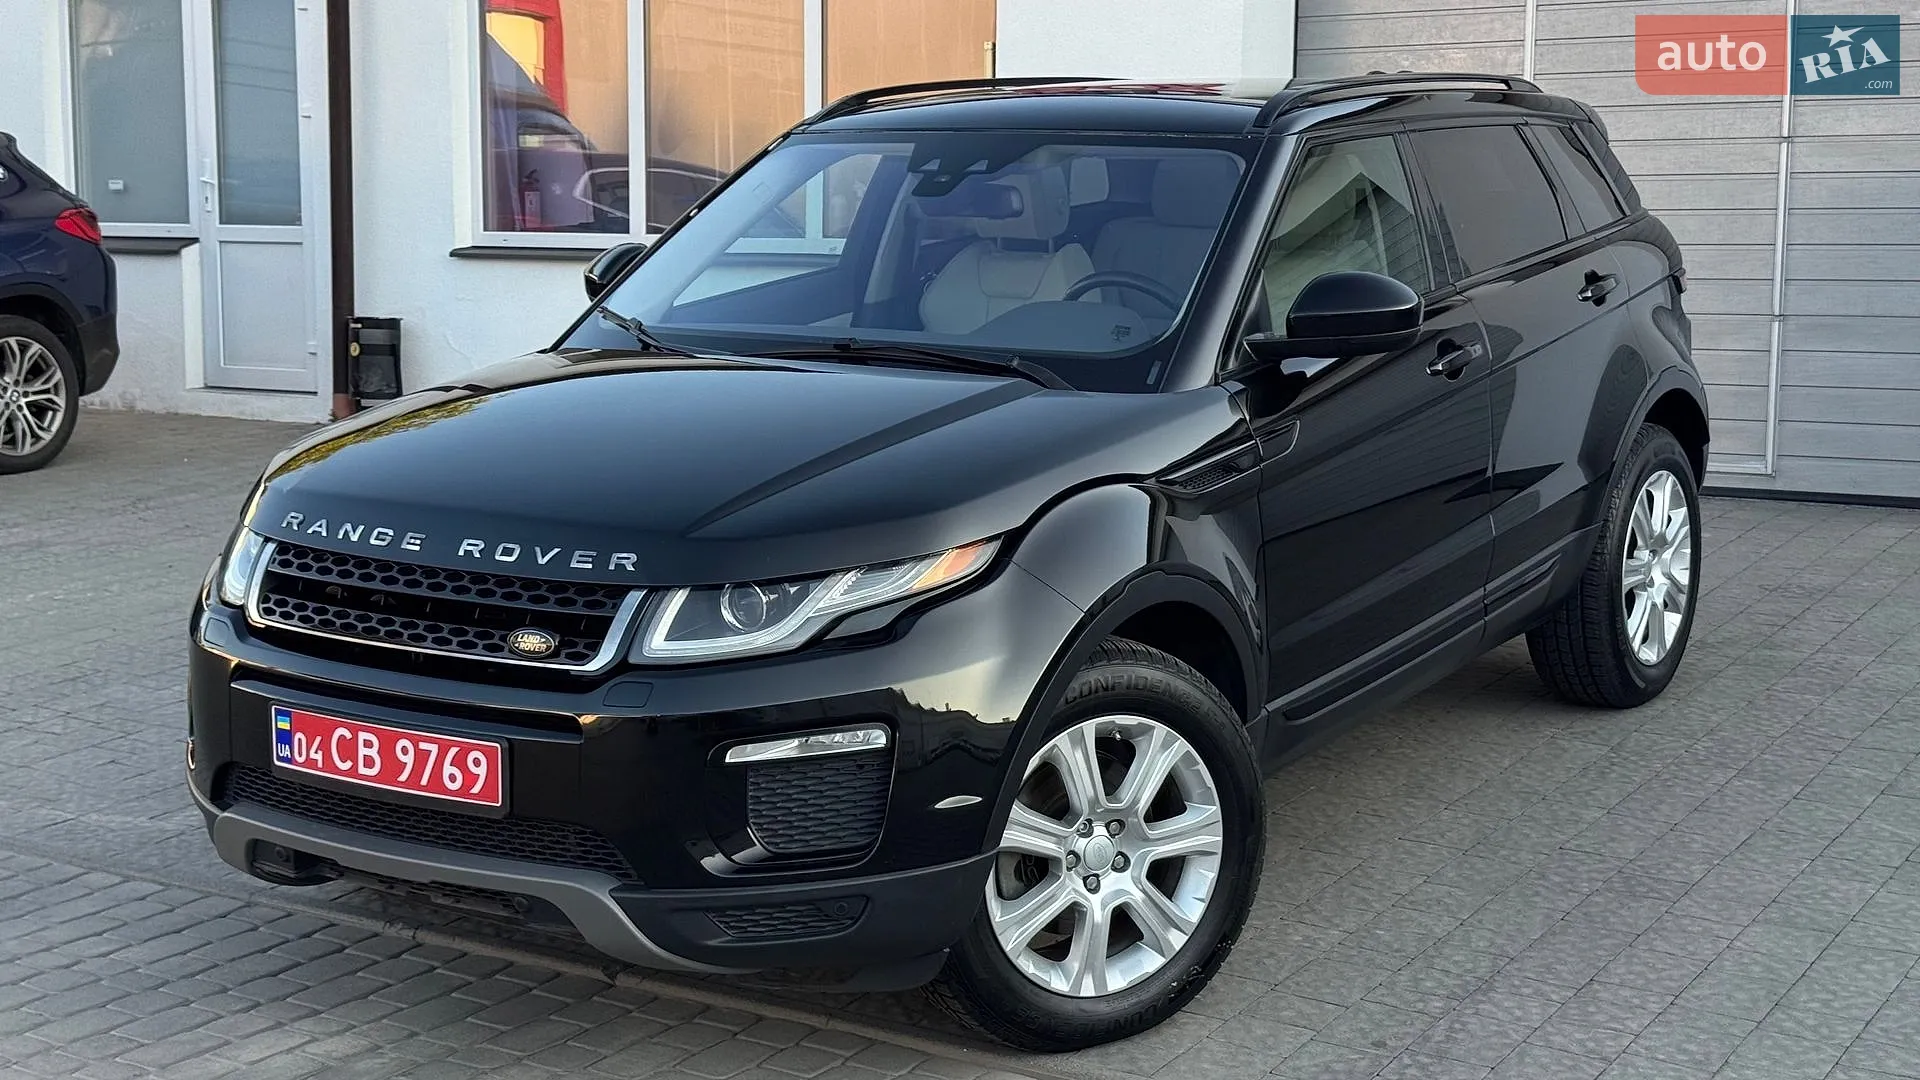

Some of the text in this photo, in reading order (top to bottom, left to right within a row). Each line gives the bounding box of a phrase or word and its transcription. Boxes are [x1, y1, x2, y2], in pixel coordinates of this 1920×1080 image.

[280, 511, 640, 573] RANGE ROVER
[517, 633, 541, 644] LAND
[518, 641, 548, 653] ROVER
[278, 742, 292, 759] UA
[293, 726, 489, 795] 04 CB 9769
